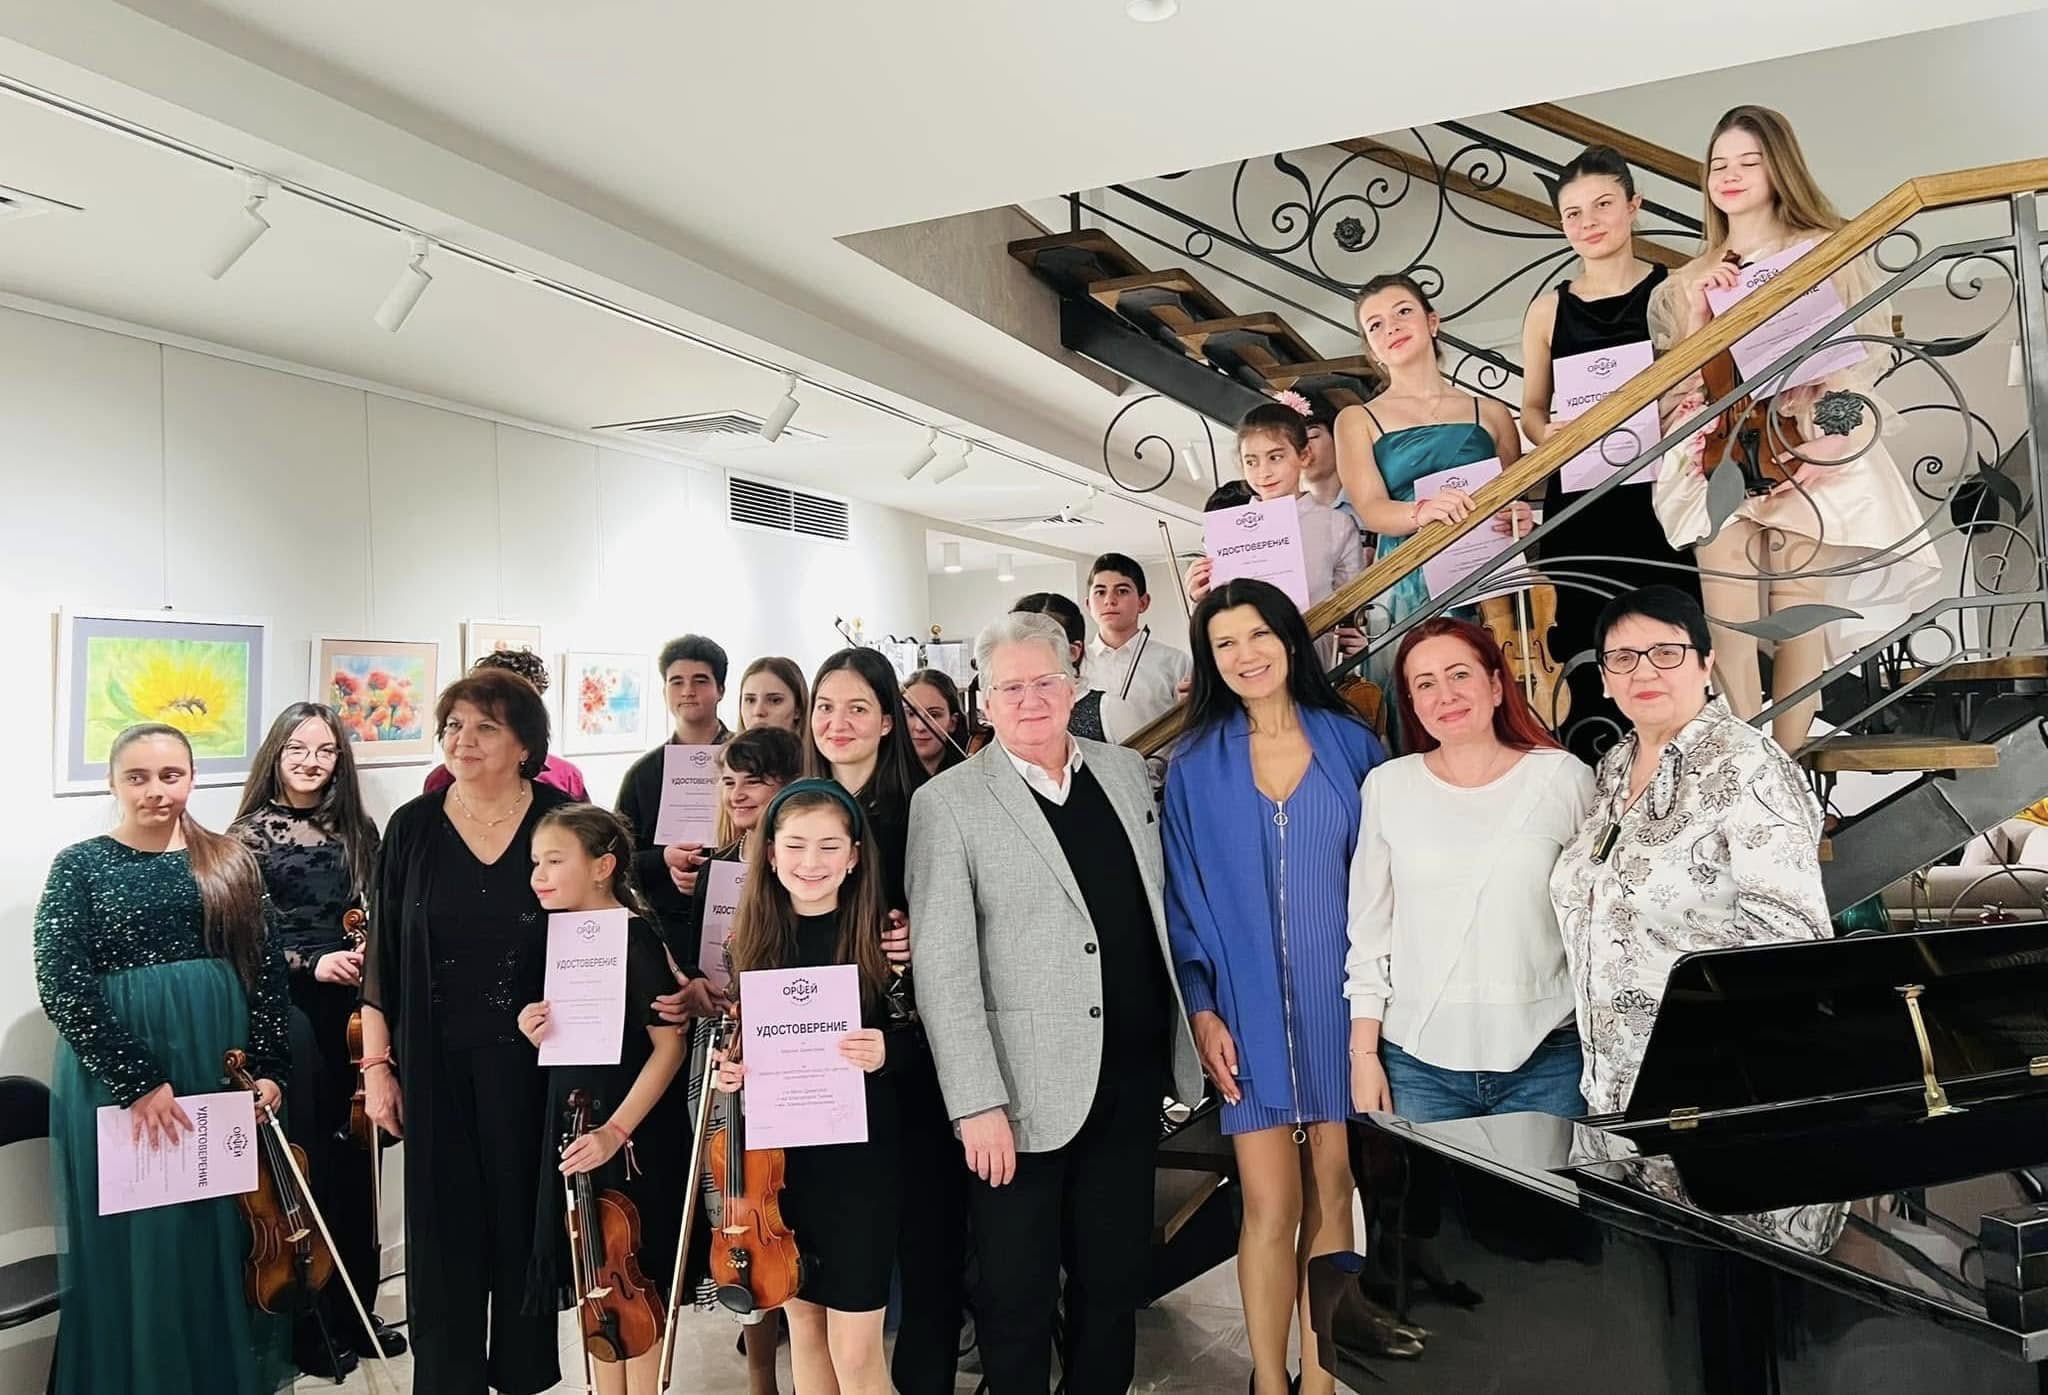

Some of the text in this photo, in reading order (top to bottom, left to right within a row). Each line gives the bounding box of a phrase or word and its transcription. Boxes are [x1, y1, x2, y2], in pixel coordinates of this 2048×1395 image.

[1217, 536, 1290, 556] УДОСТОВЕРЕНИЕ
[556, 956, 617, 970] УДОСТОВЕРЕНИЕ
[757, 1020, 848, 1037] УДОСТОВЕРЕНИЕ
[197, 1106, 208, 1188] УДОСТОВЕРЕНИЕ
